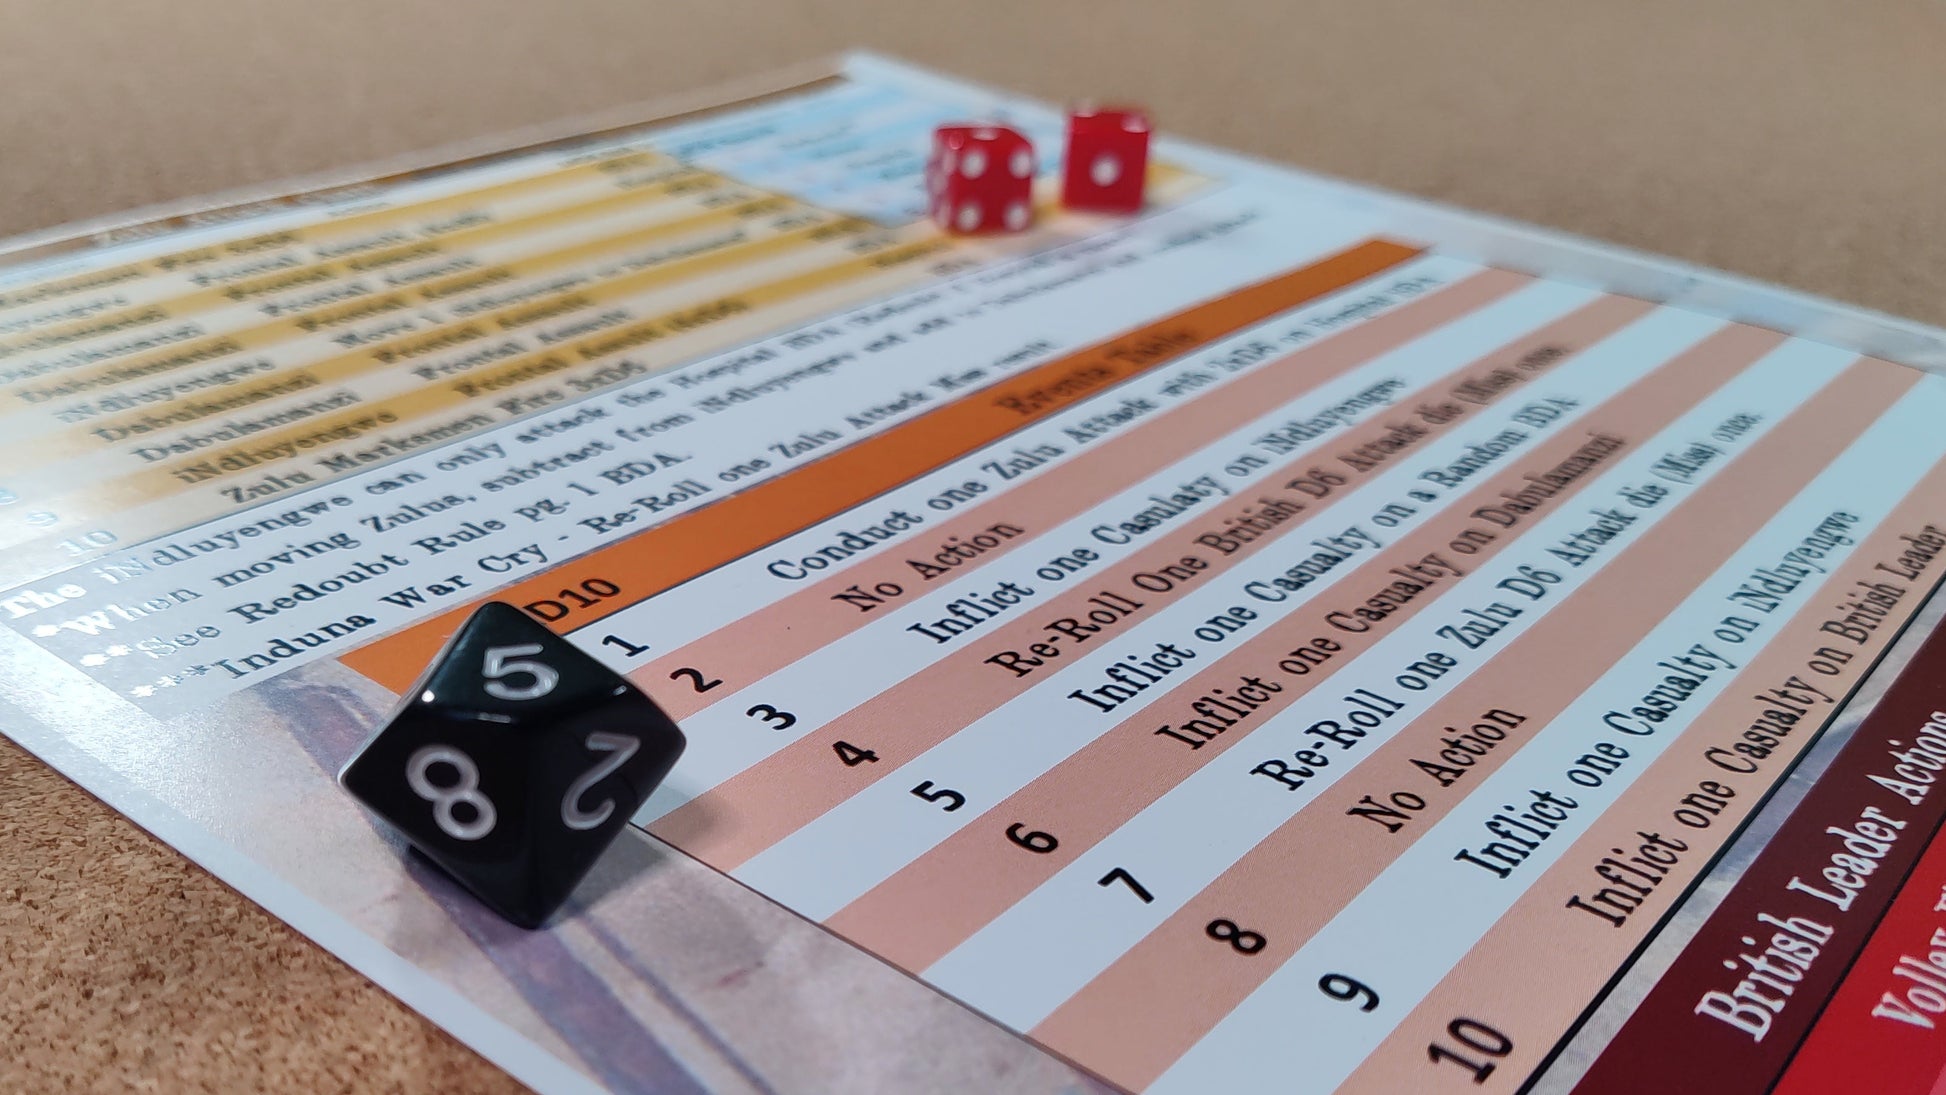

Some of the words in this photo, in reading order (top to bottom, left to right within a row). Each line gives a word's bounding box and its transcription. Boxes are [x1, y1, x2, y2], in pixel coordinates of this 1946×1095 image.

[129, 388, 363, 464] Dabulamanzi
[170, 411, 399, 485] iNdluyengwe
[220, 470, 316, 504] Zulu
[316, 412, 496, 474] Marksmen
[1417, 428, 1531, 490] Random
[1, 583, 88, 620] The
[92, 495, 354, 584] iNdluyengwe
[365, 470, 428, 496] can
[436, 442, 507, 473] only
[515, 408, 611, 444] attack
[615, 387, 667, 407] the
[210, 531, 362, 588] moving
[357, 494, 478, 534] Zulus,
[480, 439, 616, 493] subtract
[614, 412, 696, 443] from
[378, 574, 474, 611] War
[476, 543, 550, 574] Cry
[576, 478, 714, 536] Re-Roll
[717, 457, 773, 484] one
[768, 428, 844, 460] Zulu
[844, 387, 930, 430] Attack
[766, 510, 924, 581] Conduct
[926, 480, 989, 512] one
[980, 441, 1065, 481] Zulu
[1062, 397, 1160, 445] Attack
[1371, 502, 1418, 529] on
[1407, 488, 1438, 503] a
[225, 551, 410, 625] Redoubt
[409, 517, 507, 556] Rule
[512, 497, 572, 523] pg.
[566, 480, 601, 498] 1
[597, 452, 694, 487] BDA.
[830, 581, 905, 613] No
[905, 521, 1027, 581] Action
[906, 581, 1036, 645] Inflict
[1036, 547, 1101, 582] one
[1089, 474, 1230, 546] Casulaty
[1223, 453, 1269, 479] on
[983, 590, 1145, 679] Re-Roll
[1131, 554, 1210, 594] One
[1191, 497, 1308, 557] British
[1284, 466, 1348, 500] D6
[1243, 526, 1383, 602] Casualty
[1875, 522, 1946, 583] Leader
[522, 578, 622, 623] D10
[1193, 606, 1258, 643] one
[1820, 580, 1907, 646] British
[482, 643, 560, 700] 5
[602, 634, 651, 658] 1
[1153, 676, 1283, 751] Inflict
[1279, 637, 1342, 676] one
[1324, 553, 1465, 634] Casualty
[1449, 528, 1498, 555] on
[1249, 688, 1406, 792] Re-Roll
[1395, 651, 1459, 692] one
[1435, 602, 1524, 650] Zulu
[1495, 565, 1564, 601] D6
[1545, 507, 1639, 569] Attack
[1617, 486, 1671, 509] die
[1808, 646, 1853, 677] on
[669, 667, 724, 694] 2
[1066, 643, 1197, 713] Inflict
[746, 704, 797, 731] 3
[1453, 788, 1580, 879] Inflict
[1566, 741, 1630, 789] one
[1601, 642, 1738, 737] Casualty
[1713, 615, 1760, 645] on
[1704, 674, 1836, 774] Casualty
[832, 740, 880, 768] 4
[1345, 790, 1426, 834] No
[1408, 708, 1528, 788] Action
[405, 744, 498, 840] 8
[909, 780, 967, 812] 5
[1673, 780, 1737, 829] one
[1005, 822, 1059, 854] 6
[1097, 866, 1155, 904] 7
[1565, 829, 1689, 928] Inflict
[1205, 918, 1267, 956] 8
[1694, 912, 1836, 1043] British
[1786, 805, 1909, 912] Leader
[1317, 972, 1380, 1013] 9
[1427, 1016, 1514, 1086] 10
